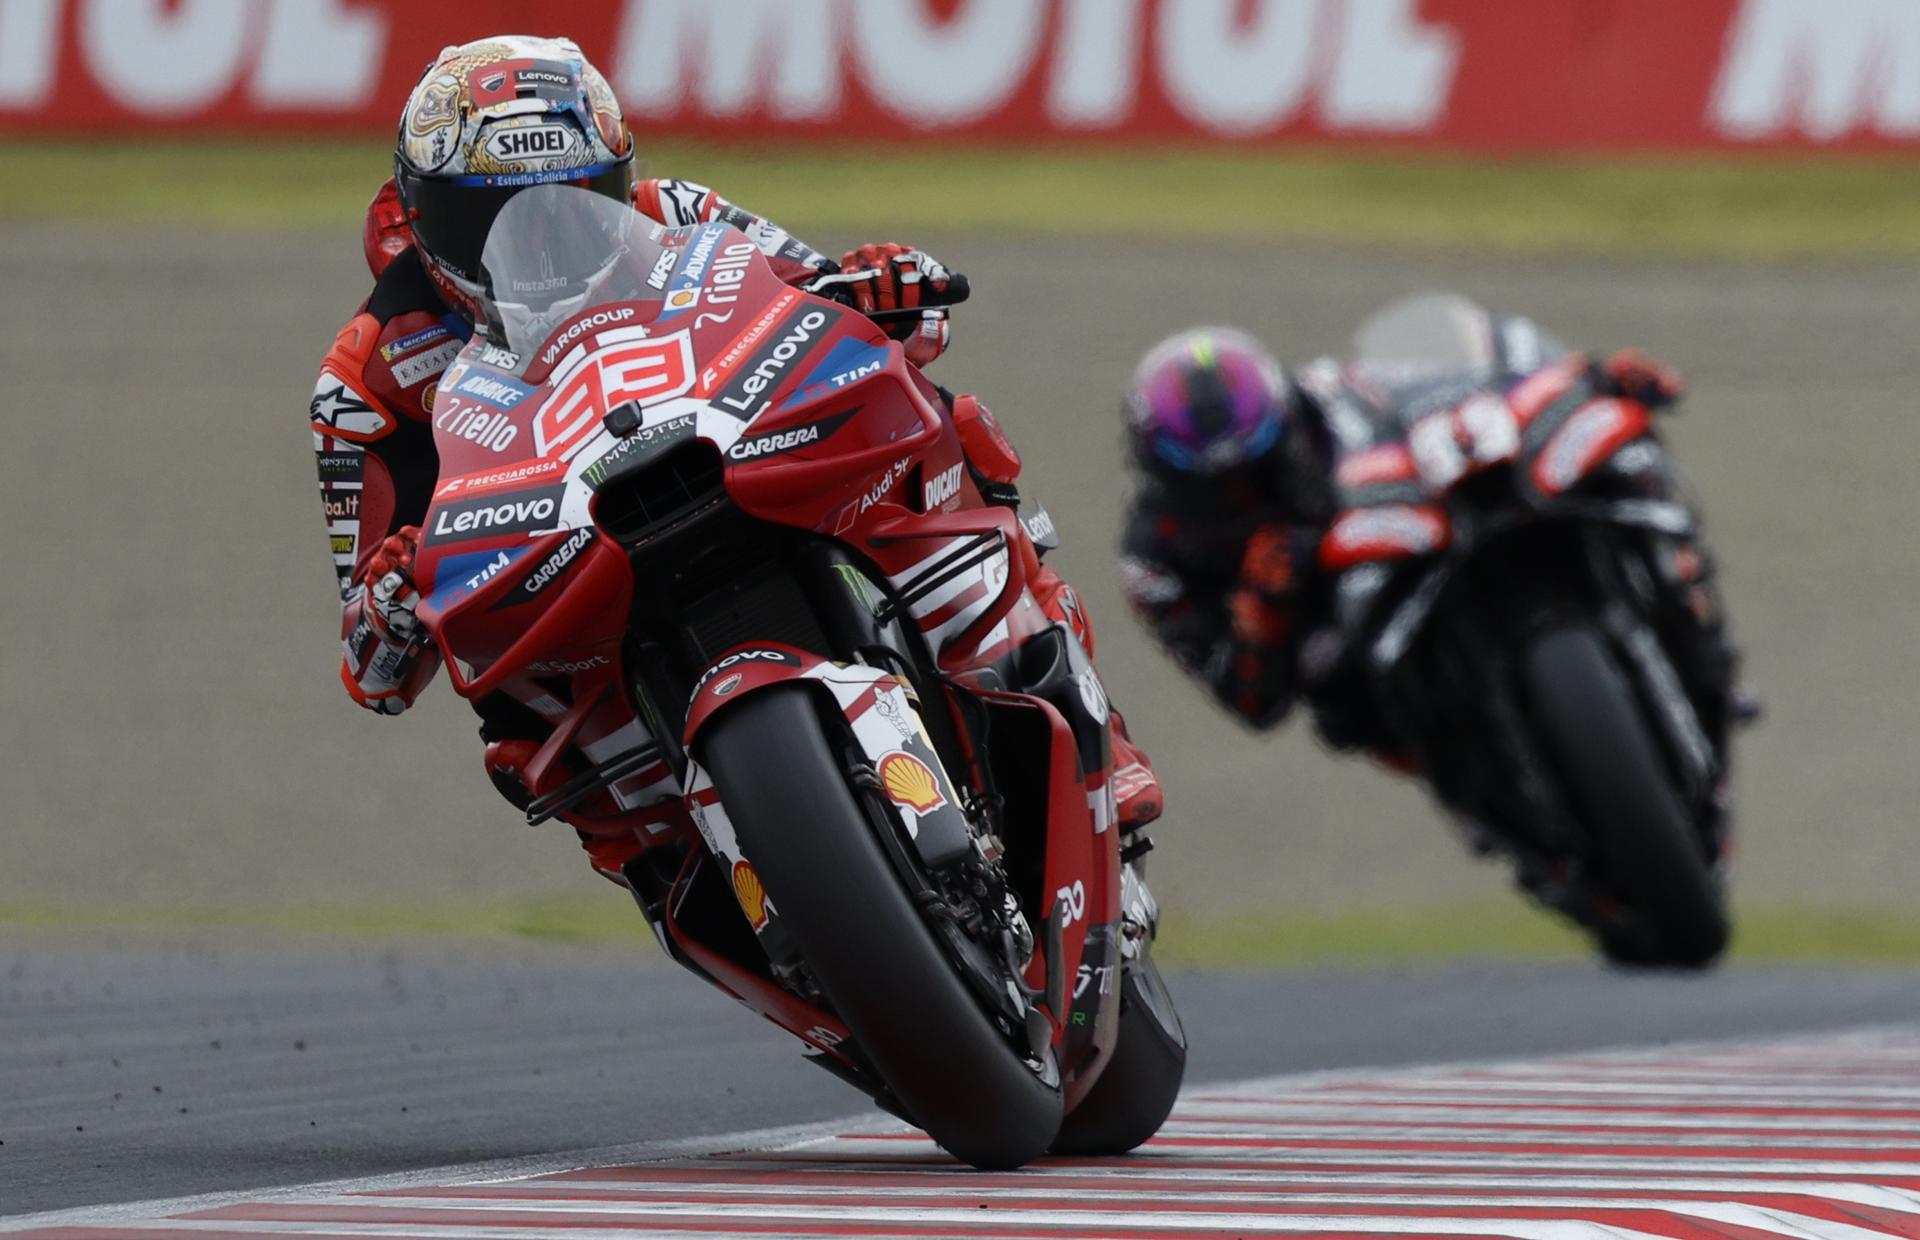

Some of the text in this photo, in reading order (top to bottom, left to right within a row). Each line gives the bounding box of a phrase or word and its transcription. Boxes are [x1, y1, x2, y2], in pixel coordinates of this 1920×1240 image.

[518, 71, 568, 84] Lenovo
[498, 130, 564, 155] SHOEI
[497, 174, 534, 186] Estrella
[535, 172, 568, 184] Galicia
[647, 249, 678, 290] WRS
[680, 225, 724, 281] ADVANCE
[513, 276, 568, 292] Insta360
[704, 243, 756, 305] riello
[719, 294, 794, 368] FRECCIAROSSA
[482, 342, 520, 369] WRS
[722, 311, 825, 411] Lenovo
[458, 375, 524, 407] ADVANCE
[832, 361, 881, 387] TIM
[447, 404, 518, 452] riello
[729, 425, 819, 460] CARRERA
[466, 461, 558, 488] FRECCIAROSSA
[860, 469, 893, 514] Audi
[925, 461, 964, 512] DUCATI
[324, 493, 359, 516] ba.it
[434, 498, 554, 536] Lenovo
[466, 551, 511, 590] TIM
[525, 527, 592, 592] CARRERA
[548, 655, 610, 673] Sport
